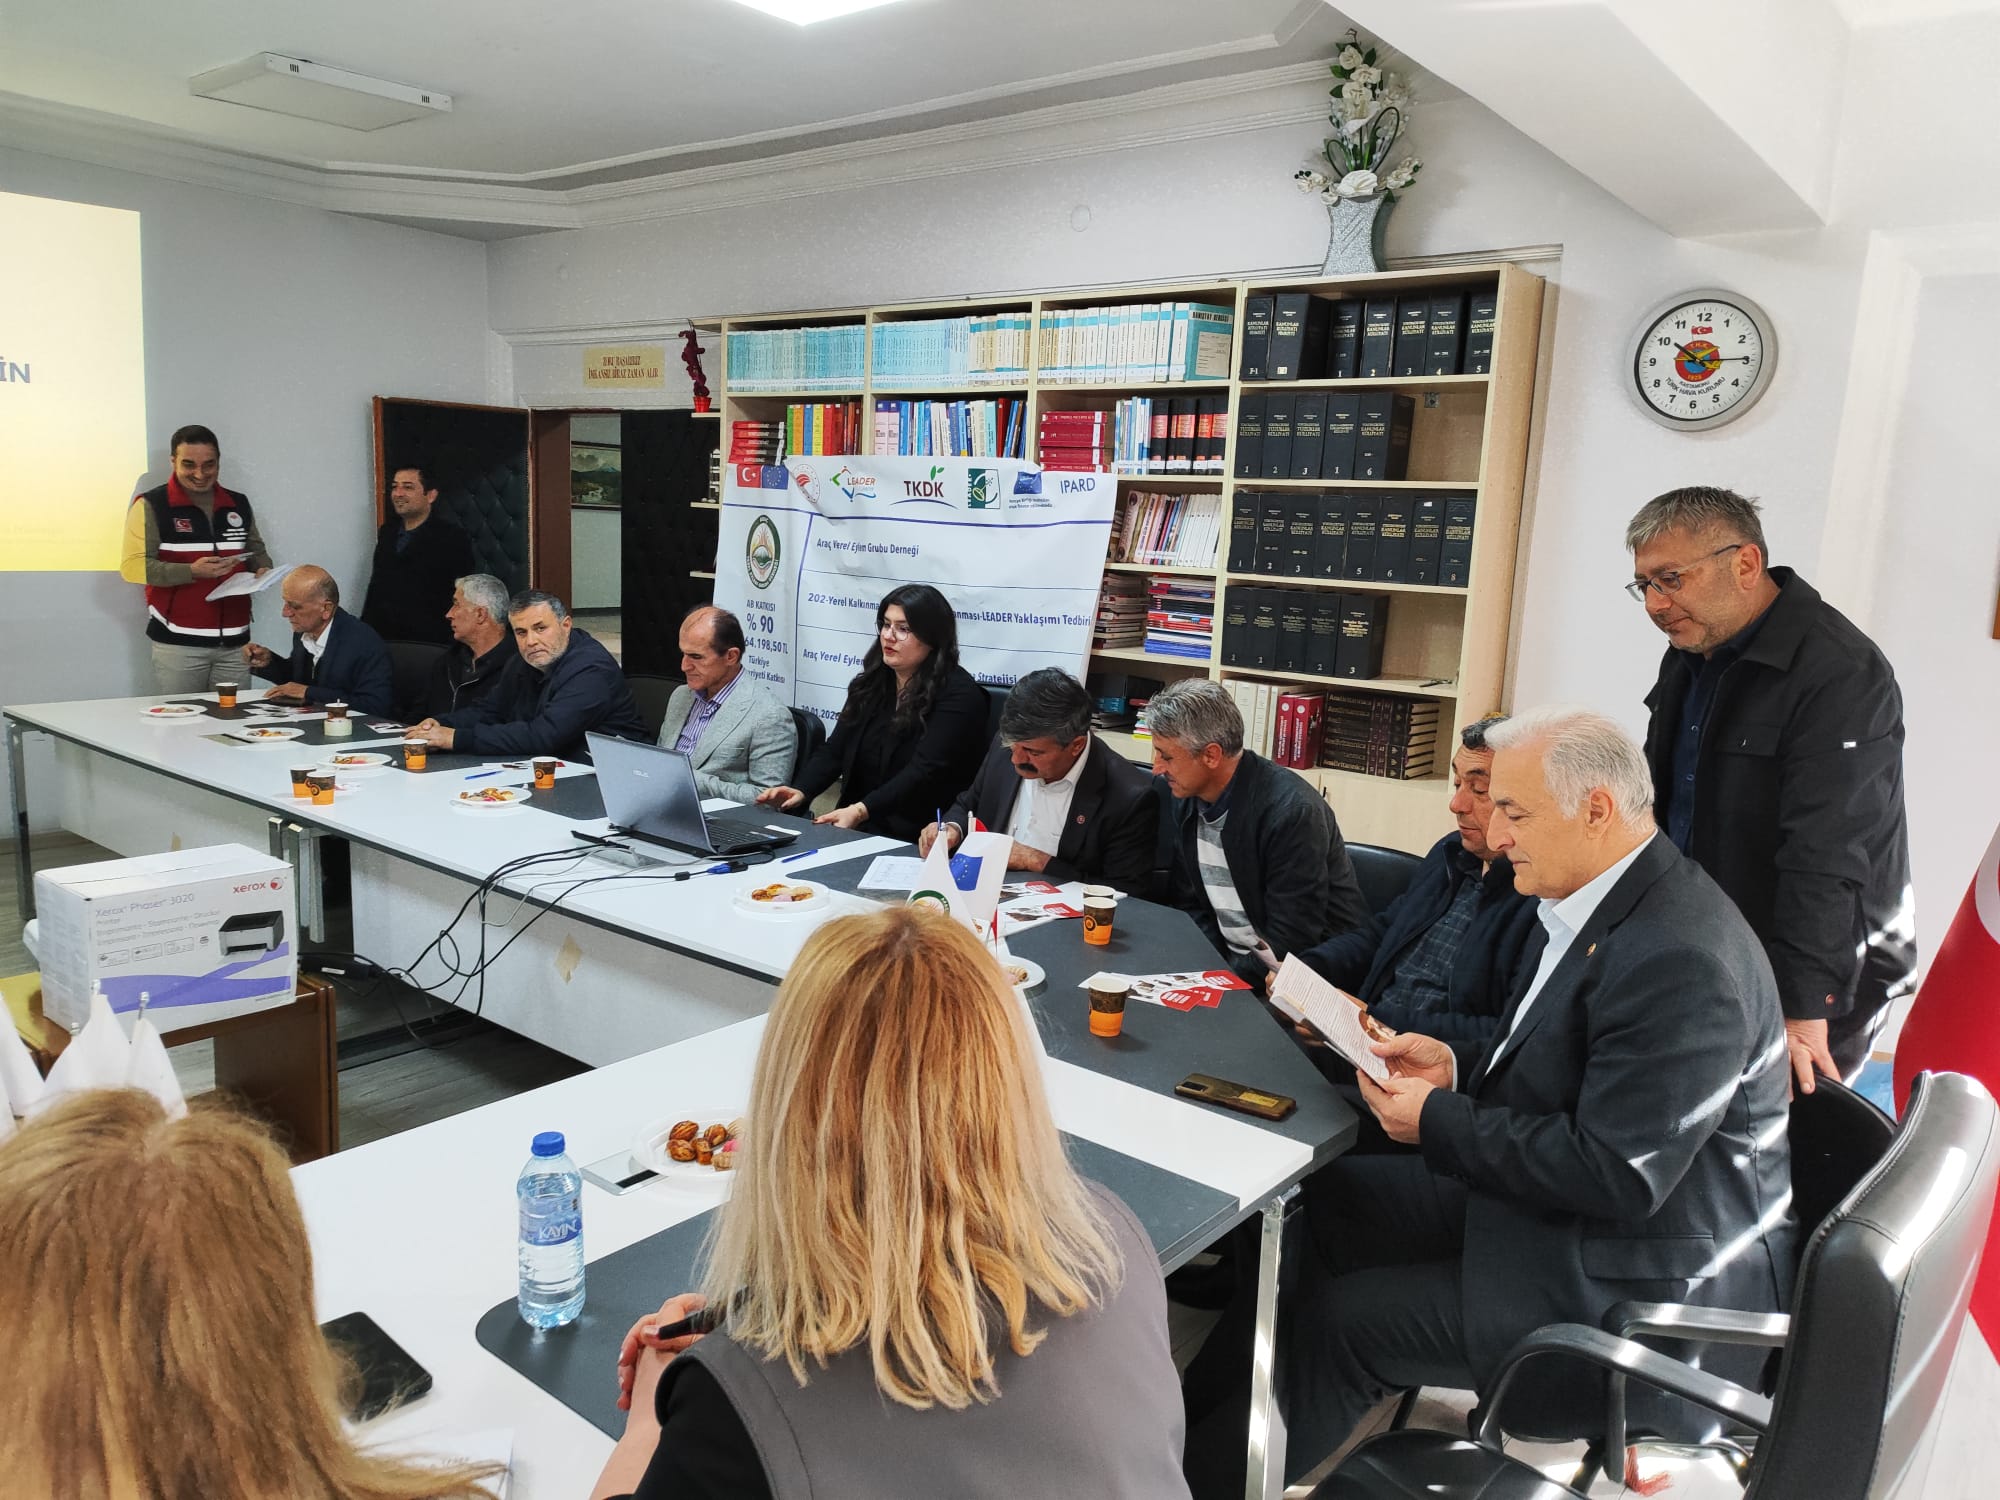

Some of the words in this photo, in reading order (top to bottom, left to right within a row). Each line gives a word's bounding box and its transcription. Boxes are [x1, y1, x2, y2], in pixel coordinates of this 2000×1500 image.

[1697, 313, 1712, 322] 12
[1675, 320, 1687, 329] 11
[1723, 318, 1730, 328] 1
[1657, 337, 1671, 346] 10
[1738, 335, 1746, 344] 2
[1649, 357, 1657, 367] 9
[1742, 356, 1750, 365] 3
[1653, 378, 1661, 388] 8
[1731, 378, 1740, 388] 4
[1669, 394, 1677, 403] 7
[1712, 393, 1720, 404] 5
[1689, 400, 1697, 409] 6
[847, 477, 876, 486] LEADER
[1060, 478, 1096, 494] IPARD
[904, 480, 944, 497] TKDK
[817, 538, 831, 550] Araç
[890, 543, 919, 557] Derneği
[746, 600, 755, 609] AB
[756, 601, 776, 612] KATKISI
[746, 613, 757, 631] %
[760, 615, 774, 634] 90
[1014, 612, 1060, 627] Yaklaşımı
[1062, 614, 1091, 626] Tedbiri
[803, 648, 818, 661] Araç
[820, 651, 841, 663] Yerel
[232, 880, 266, 895] xerox
[170, 892, 195, 906] 3020
